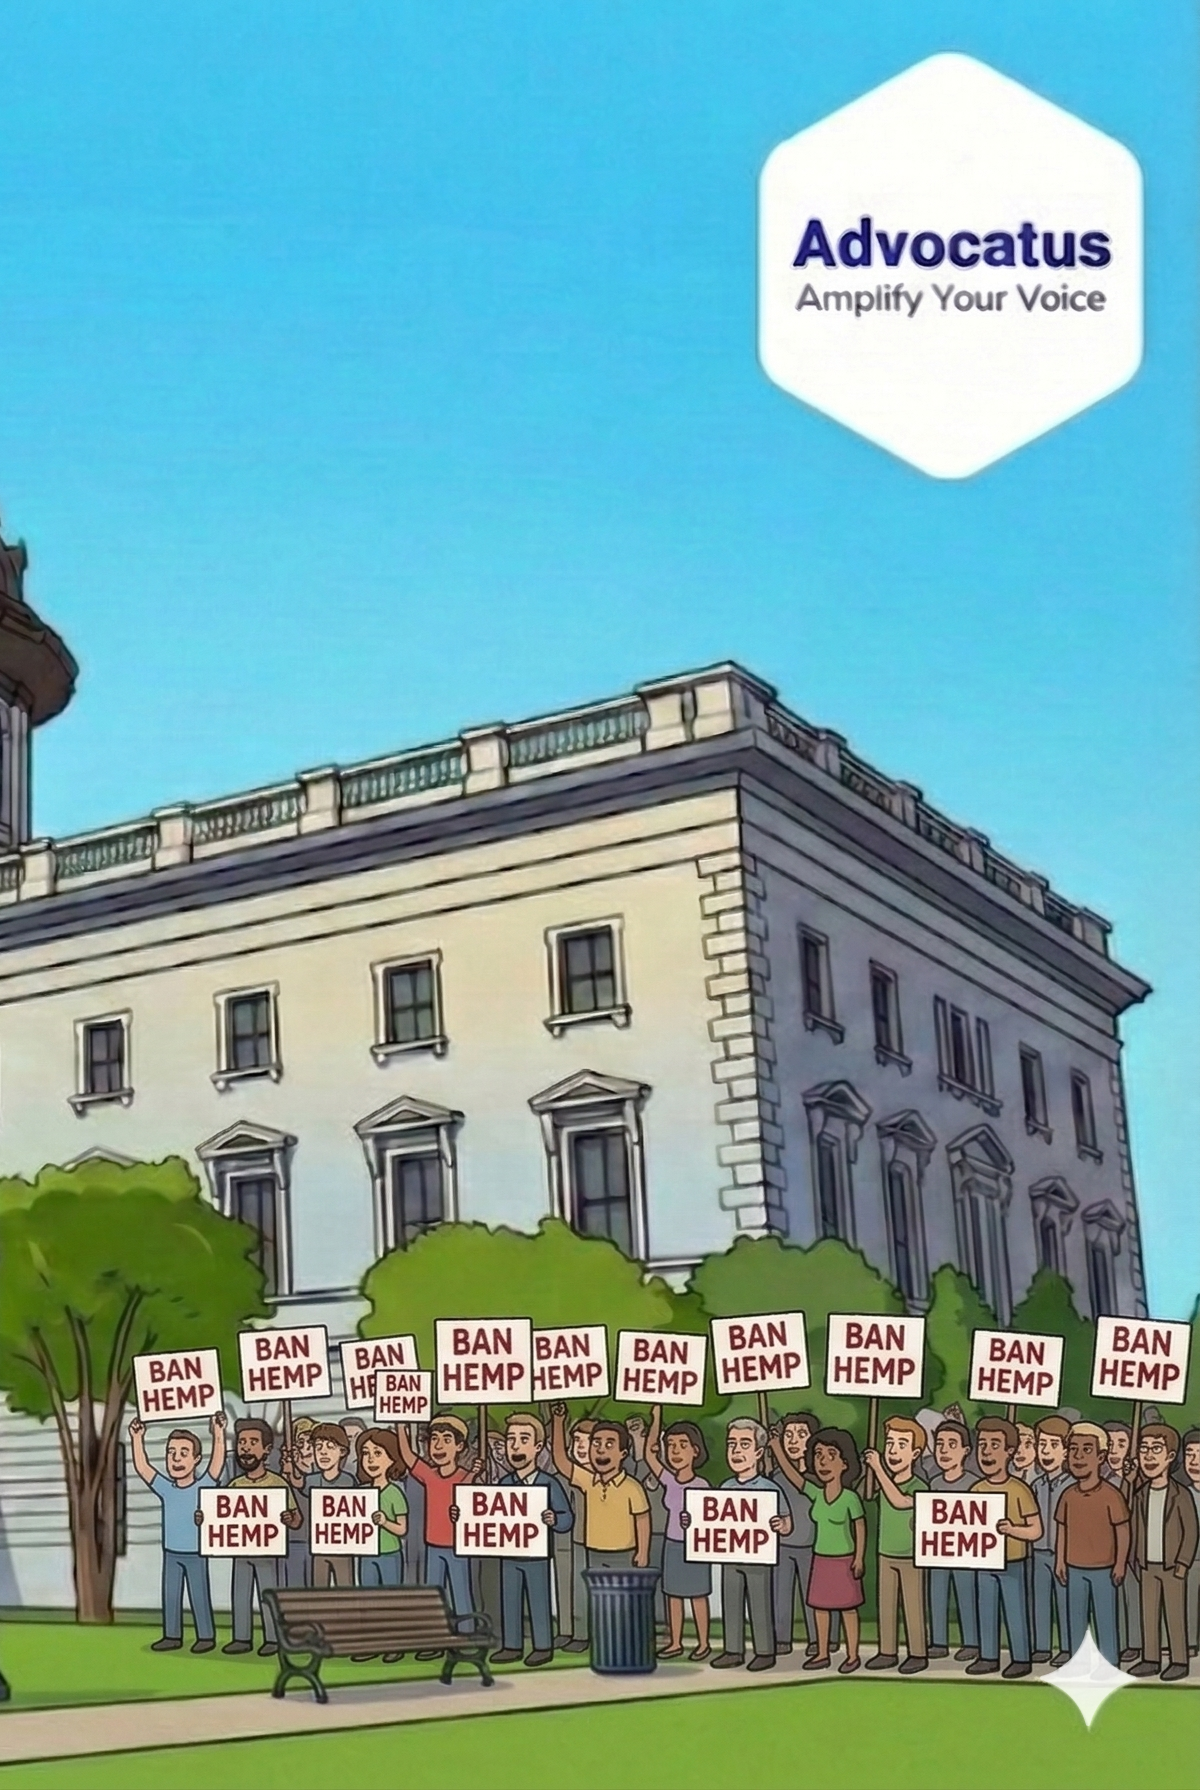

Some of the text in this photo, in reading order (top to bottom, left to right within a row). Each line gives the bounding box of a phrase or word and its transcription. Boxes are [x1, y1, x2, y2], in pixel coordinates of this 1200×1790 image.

[256, 1335, 309, 1361] BAN
[453, 1328, 512, 1355] BAN
[536, 1334, 590, 1360] BAN
[729, 1321, 787, 1350] BAN
[846, 1323, 904, 1351] BAN
[1113, 1326, 1171, 1357] BAN
[355, 1343, 404, 1370] BAN
[634, 1339, 688, 1364] BAN
[989, 1338, 1044, 1366] BAN
[150, 1357, 202, 1383] BAN
[249, 1363, 322, 1391] HEMP
[444, 1363, 524, 1391] HEMP
[722, 1352, 800, 1383] HEMP
[834, 1356, 915, 1385] HEMP
[1100, 1358, 1180, 1390] HEMP
[350, 1374, 375, 1400] HE
[386, 1375, 421, 1391] BAN
[624, 1368, 698, 1395] HEMP
[978, 1367, 1053, 1396] HEMP
[143, 1384, 214, 1412] HEMP
[380, 1396, 427, 1414] HEMP
[217, 1495, 267, 1518] BAN
[323, 1495, 366, 1517] BAN
[473, 1492, 527, 1516] BAN
[703, 1496, 757, 1522] BAN
[932, 1499, 987, 1525] BAN
[209, 1524, 278, 1547] HEMP
[316, 1523, 373, 1544] HEMP
[464, 1523, 539, 1548] HEMP
[694, 1528, 769, 1553] HEMP
[922, 1531, 997, 1557] HEMP
